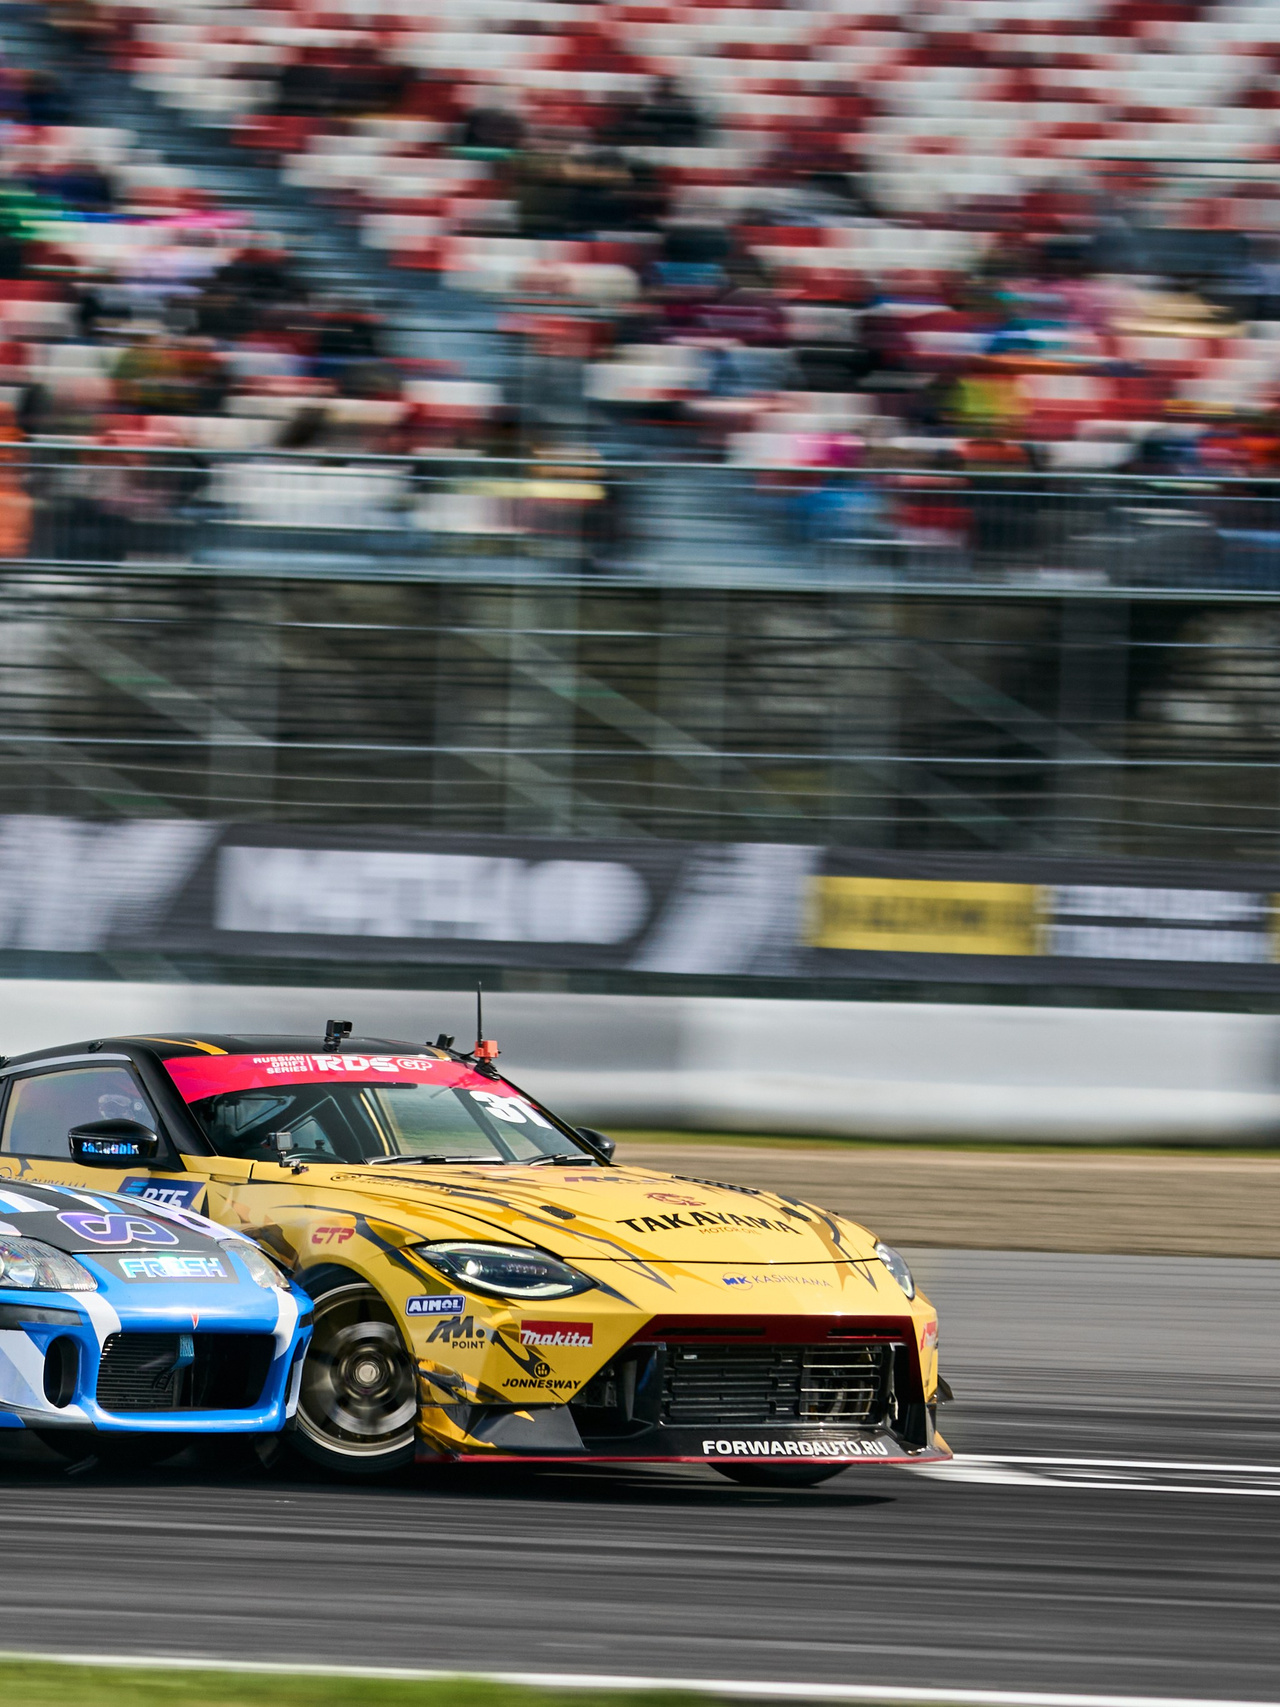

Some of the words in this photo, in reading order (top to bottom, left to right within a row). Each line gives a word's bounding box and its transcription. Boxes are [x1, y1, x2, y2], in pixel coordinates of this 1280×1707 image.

[253, 1056, 304, 1064] RUSSIAN
[312, 1056, 400, 1072] RDS
[396, 1058, 433, 1071] GP
[266, 1066, 308, 1075] SERIES
[469, 1090, 553, 1130] 31
[616, 1210, 804, 1236] TAKAYAMA
[698, 1226, 739, 1235] MOTOR
[722, 1275, 753, 1287] MK
[752, 1274, 834, 1289] KASHIYAMA
[408, 1299, 462, 1312] AIMOL
[451, 1341, 486, 1350] POINT
[501, 1378, 582, 1390] JONNESWAY
[702, 1440, 889, 1456] FORWARDAUTO.RU
